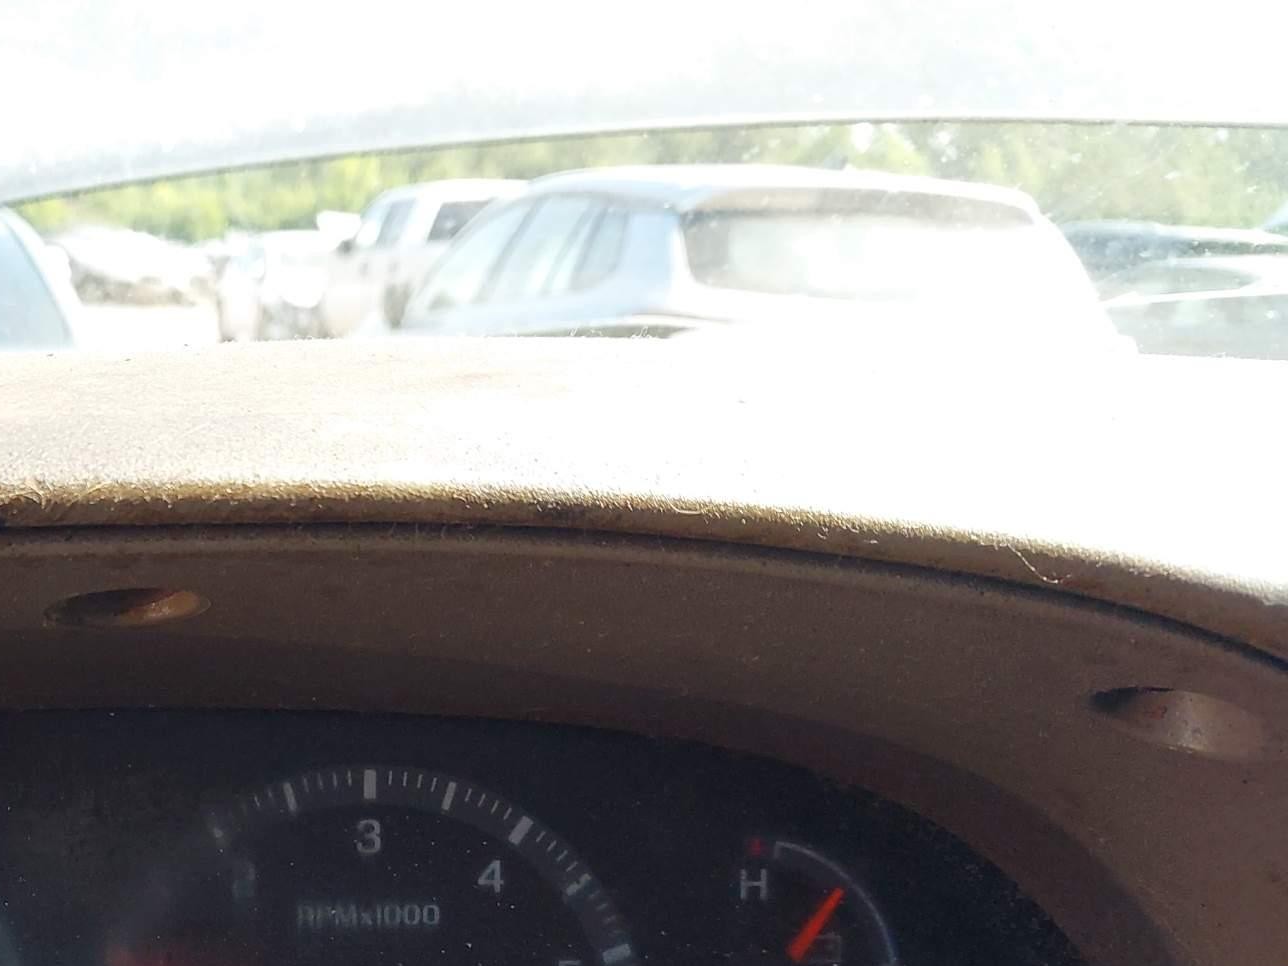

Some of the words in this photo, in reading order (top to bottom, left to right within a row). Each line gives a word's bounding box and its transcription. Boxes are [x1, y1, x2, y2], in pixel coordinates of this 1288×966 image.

[355, 818, 383, 856] 3
[476, 858, 505, 894] 4
[739, 868, 768, 901] H
